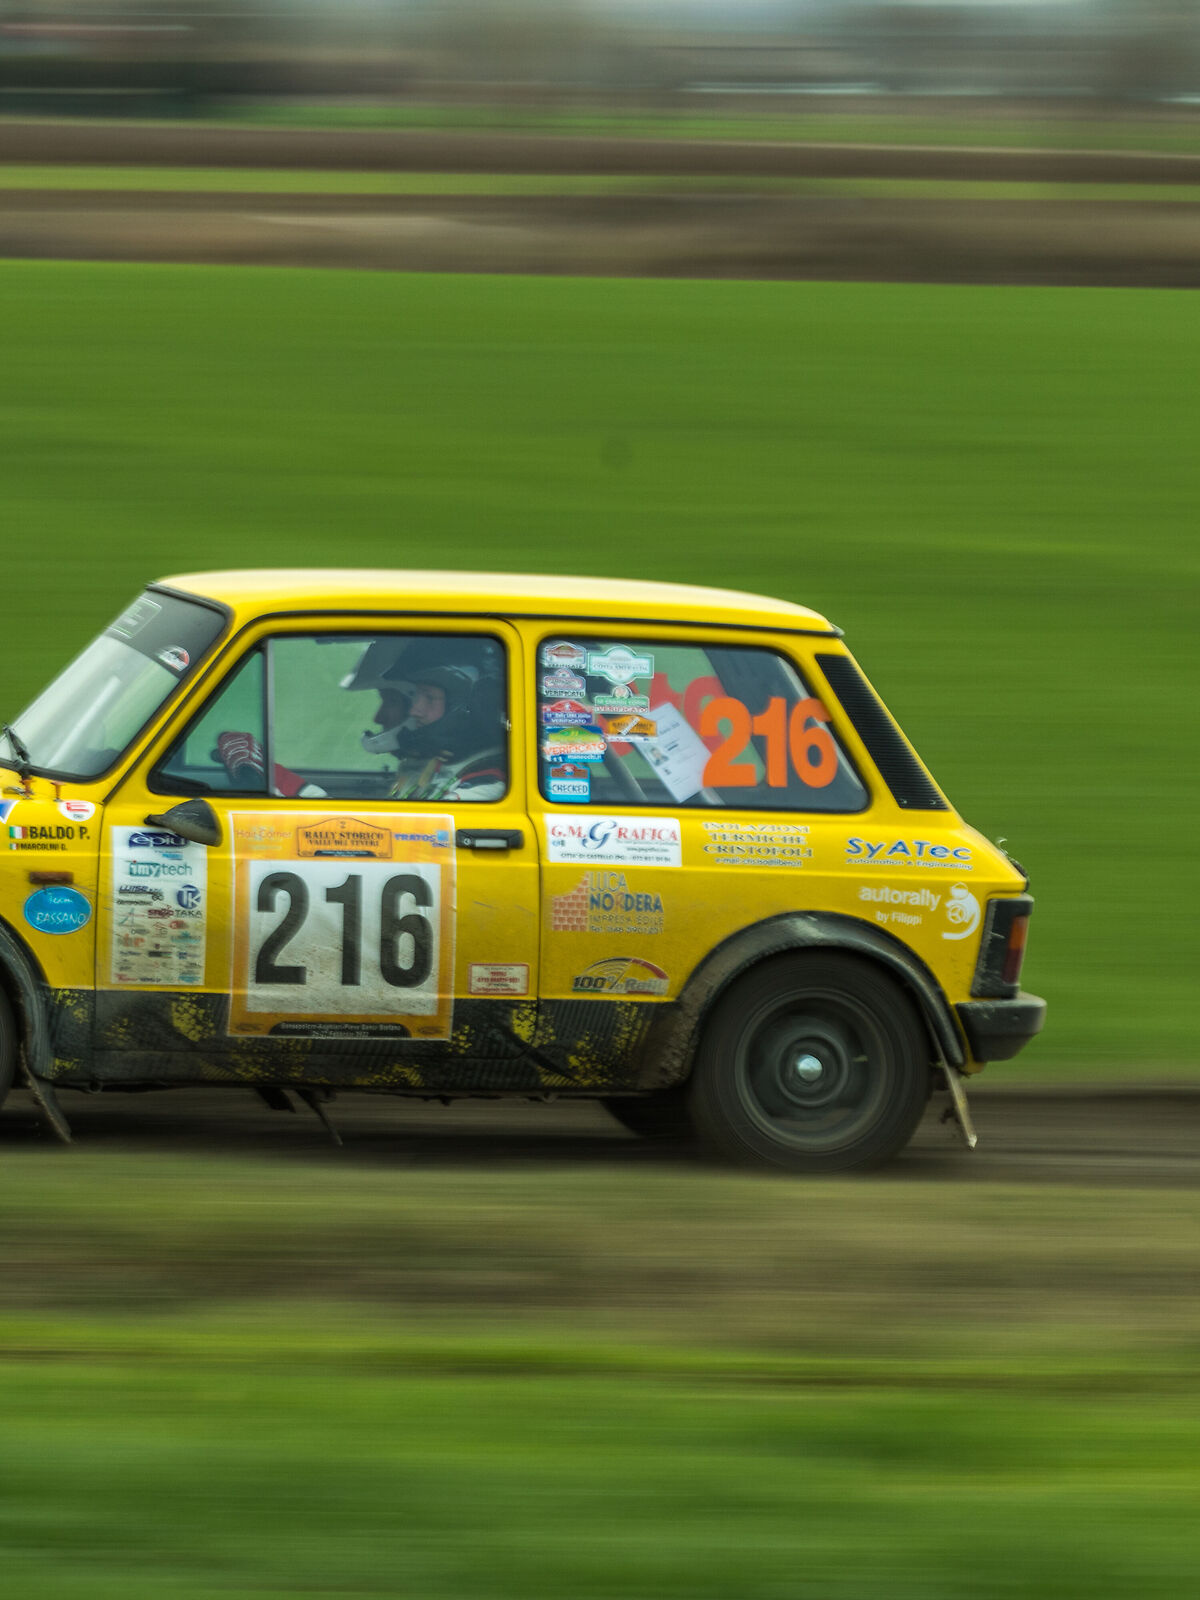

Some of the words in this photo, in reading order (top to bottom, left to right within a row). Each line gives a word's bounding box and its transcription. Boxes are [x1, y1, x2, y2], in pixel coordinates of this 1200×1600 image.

[543, 742, 607, 756] VERIFICATO
[700, 696, 838, 788] 216
[552, 784, 588, 794] CHECKED
[30, 826, 74, 840] BALDO
[80, 826, 90, 840] P.
[703, 822, 810, 834] ISOLAZIONI
[304, 831, 338, 839] RALLY
[339, 832, 384, 840] STORICO
[394, 833, 436, 842] TRATOS
[708, 832, 806, 844] TERMICHE
[703, 844, 814, 858] CRISTOFOLI
[846, 838, 972, 860] SyATec
[846, 858, 904, 866] Automation
[916, 860, 972, 870] Engineering
[589, 872, 629, 892] LUCA
[590, 892, 664, 912] NORDERA
[859, 886, 941, 911] autorally
[36, 912, 86, 924] BASSANO
[876, 912, 889, 924] by
[892, 912, 922, 925] Filippi
[255, 872, 434, 988] 216
[573, 976, 625, 990] 100%
